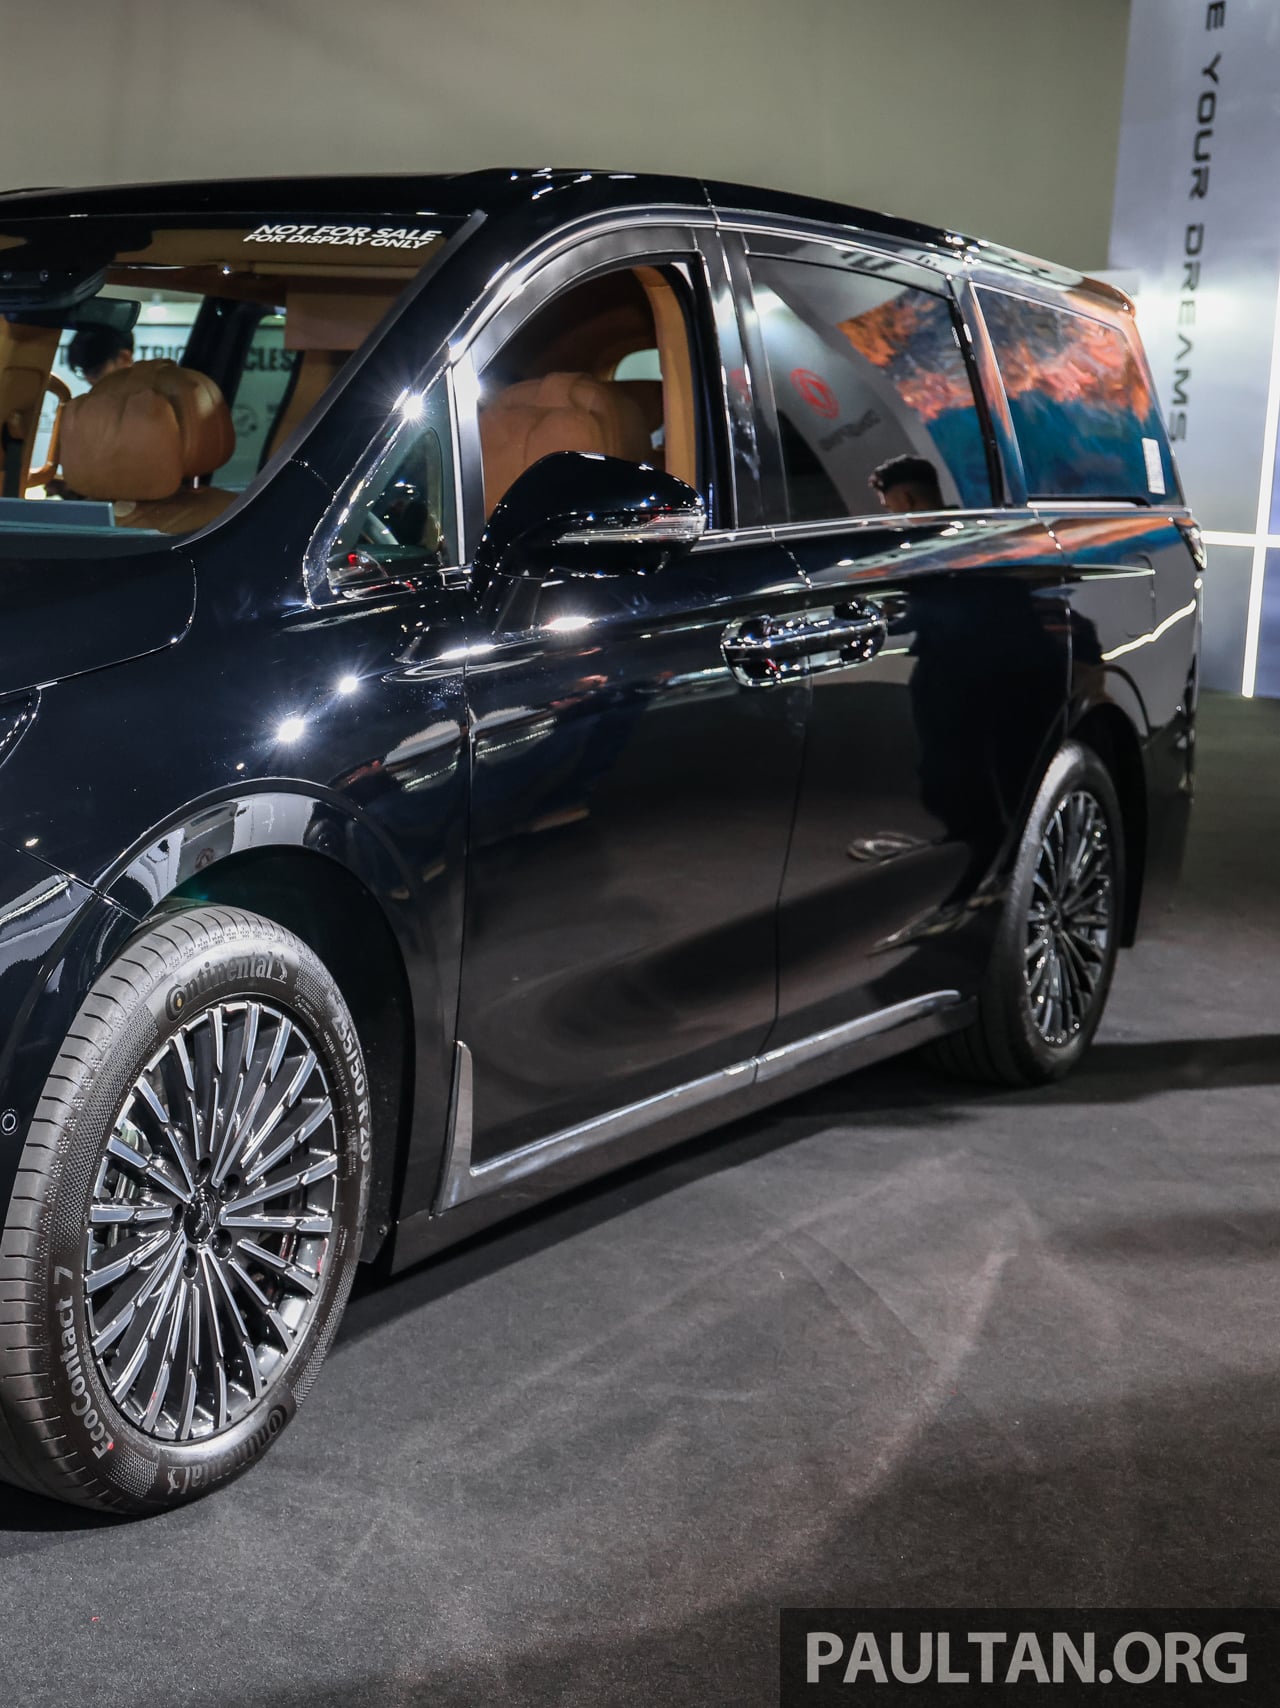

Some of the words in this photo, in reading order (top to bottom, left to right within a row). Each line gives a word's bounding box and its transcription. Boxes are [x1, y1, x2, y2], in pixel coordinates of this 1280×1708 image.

[1189, 53, 1222, 200] YOUR
[243, 233, 287, 243] FOR
[286, 234, 372, 246] DISPLAY
[370, 238, 430, 249] ONLY
[254, 224, 316, 236] NOT
[312, 225, 371, 238] FOR
[371, 228, 442, 241] SALE
[1169, 223, 1205, 443] DREAMS
[165, 952, 275, 1021] Continental
[55, 1295, 115, 1460] EcoContact
